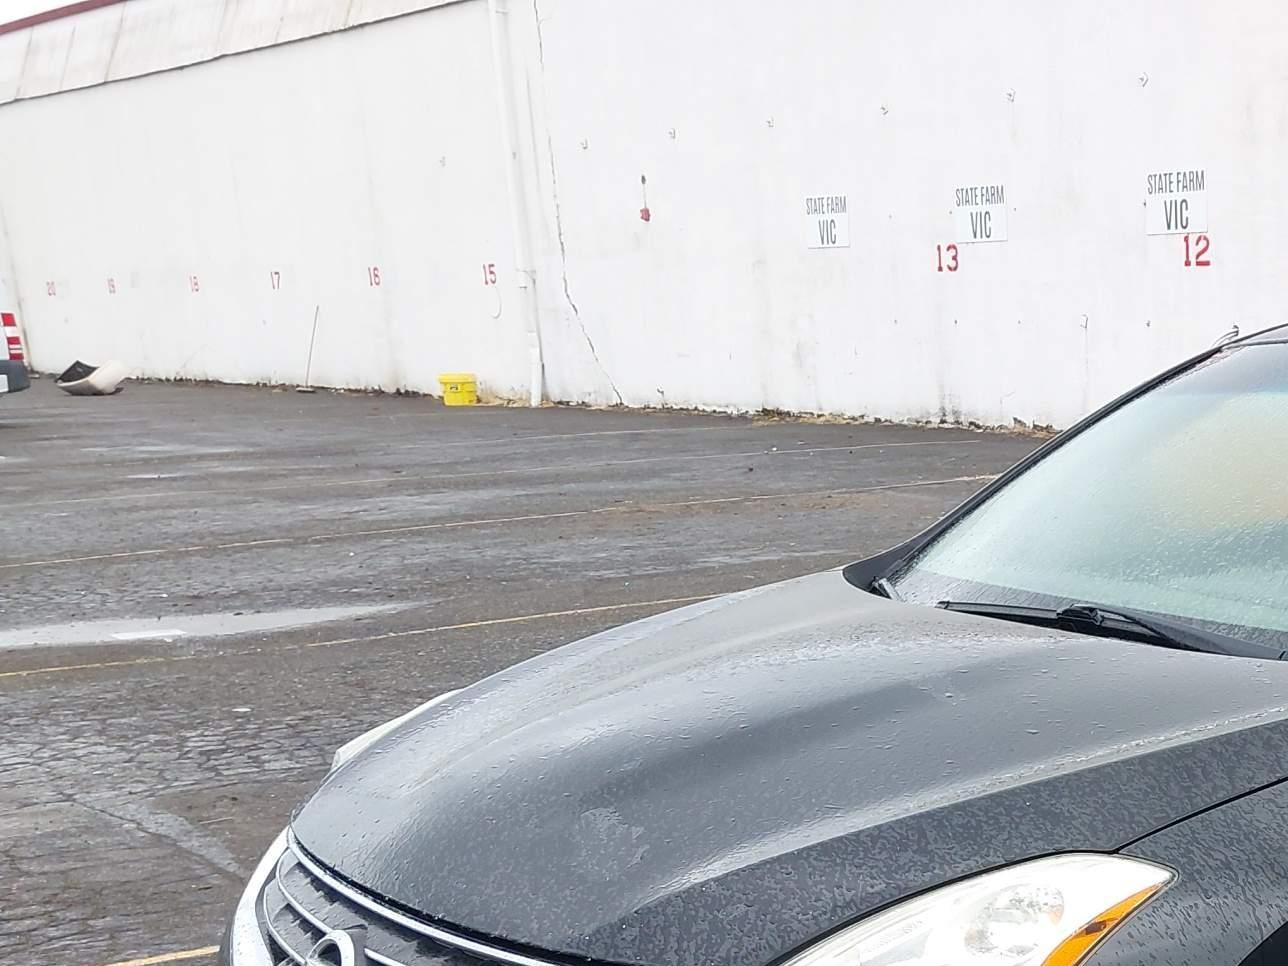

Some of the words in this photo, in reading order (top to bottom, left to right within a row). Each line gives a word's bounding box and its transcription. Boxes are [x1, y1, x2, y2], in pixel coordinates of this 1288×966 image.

[1147, 171, 1174, 195] STATE
[1176, 169, 1205, 192] FARM
[806, 197, 825, 215] STATE
[826, 195, 847, 214] FARM
[955, 187, 979, 207] STATE
[980, 184, 1005, 205] FARM
[970, 210, 992, 239] VIC
[1164, 198, 1189, 230] VIC
[818, 218, 837, 245] VIC
[936, 243, 959, 272] 13
[1183, 234, 1212, 267] 12
[270, 271, 281, 290] 17
[367, 266, 381, 287] 16
[482, 263, 497, 285] 15
